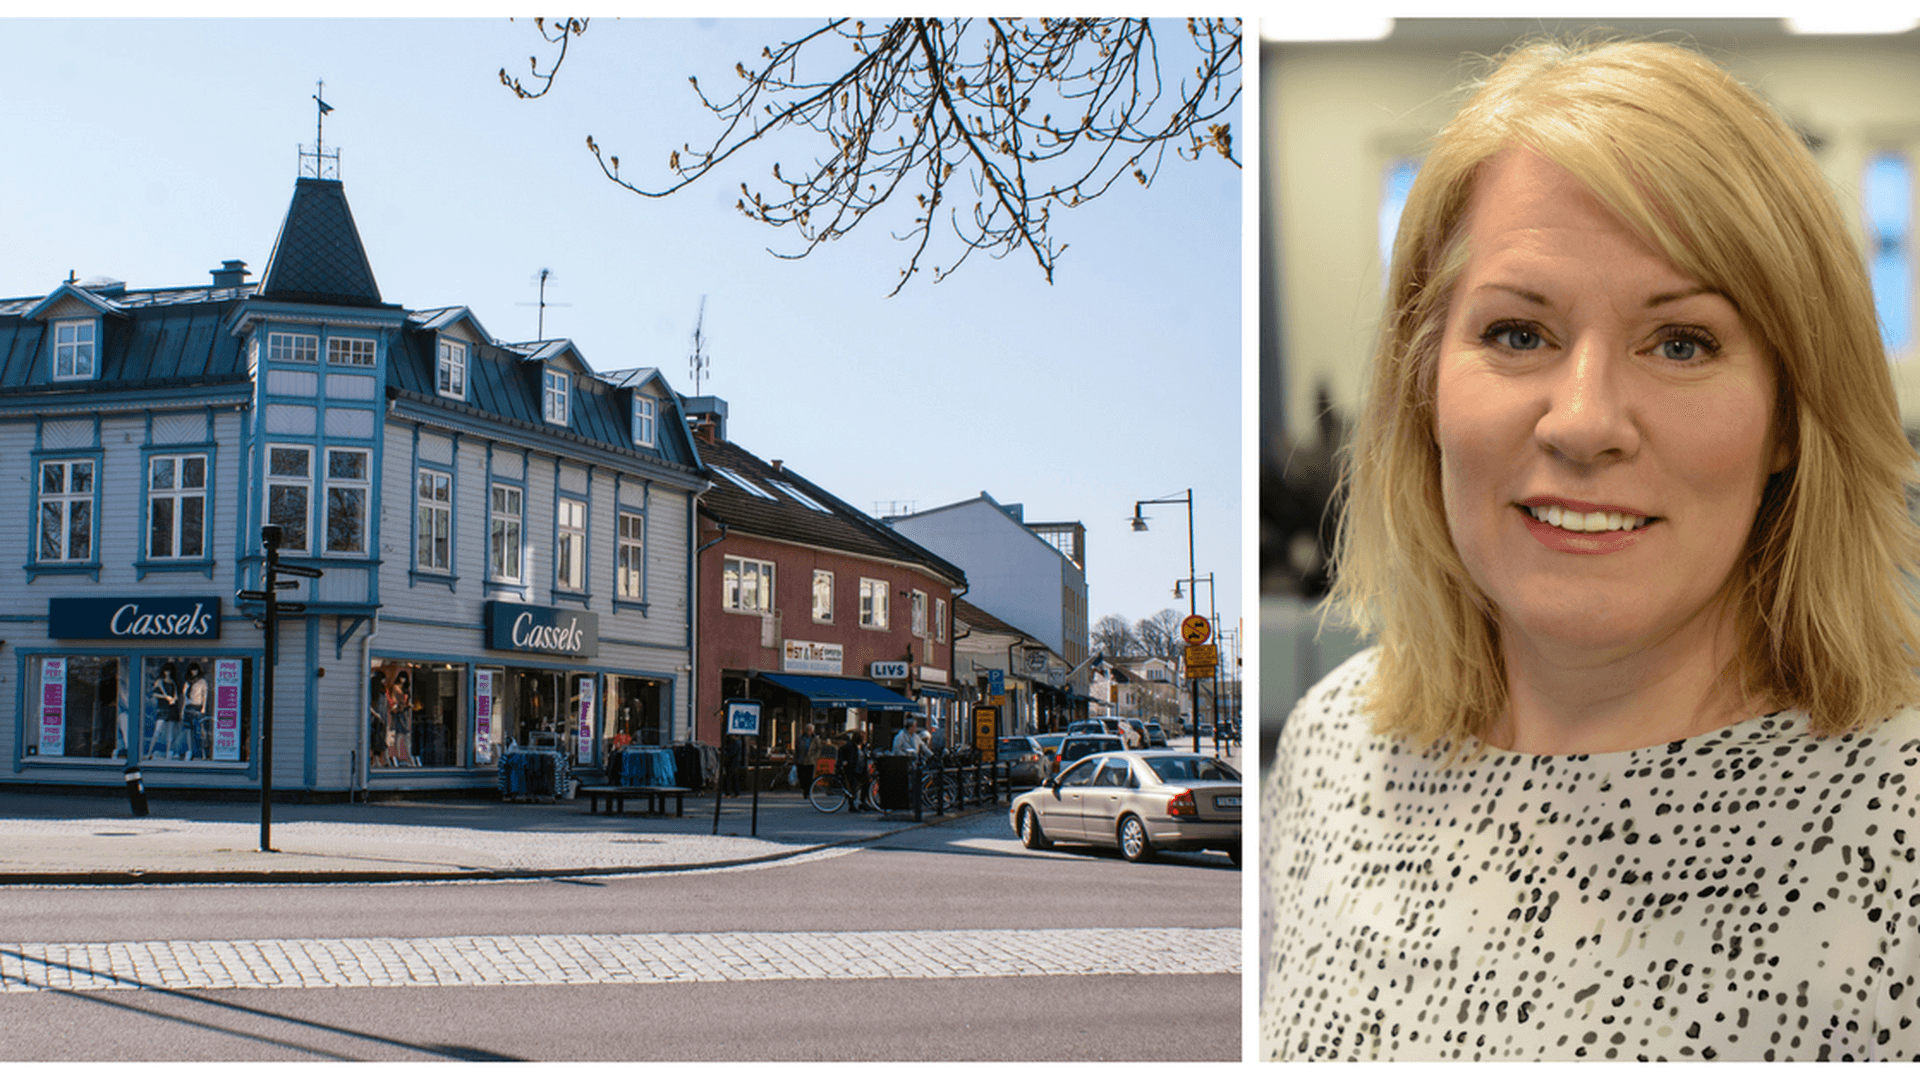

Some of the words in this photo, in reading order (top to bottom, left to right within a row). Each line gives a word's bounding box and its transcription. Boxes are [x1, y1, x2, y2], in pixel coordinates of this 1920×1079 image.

[110, 602, 213, 637] Cassels
[511, 611, 584, 653] Cassels
[874, 664, 905, 677] LIVS
[992, 671, 1000, 681] P
